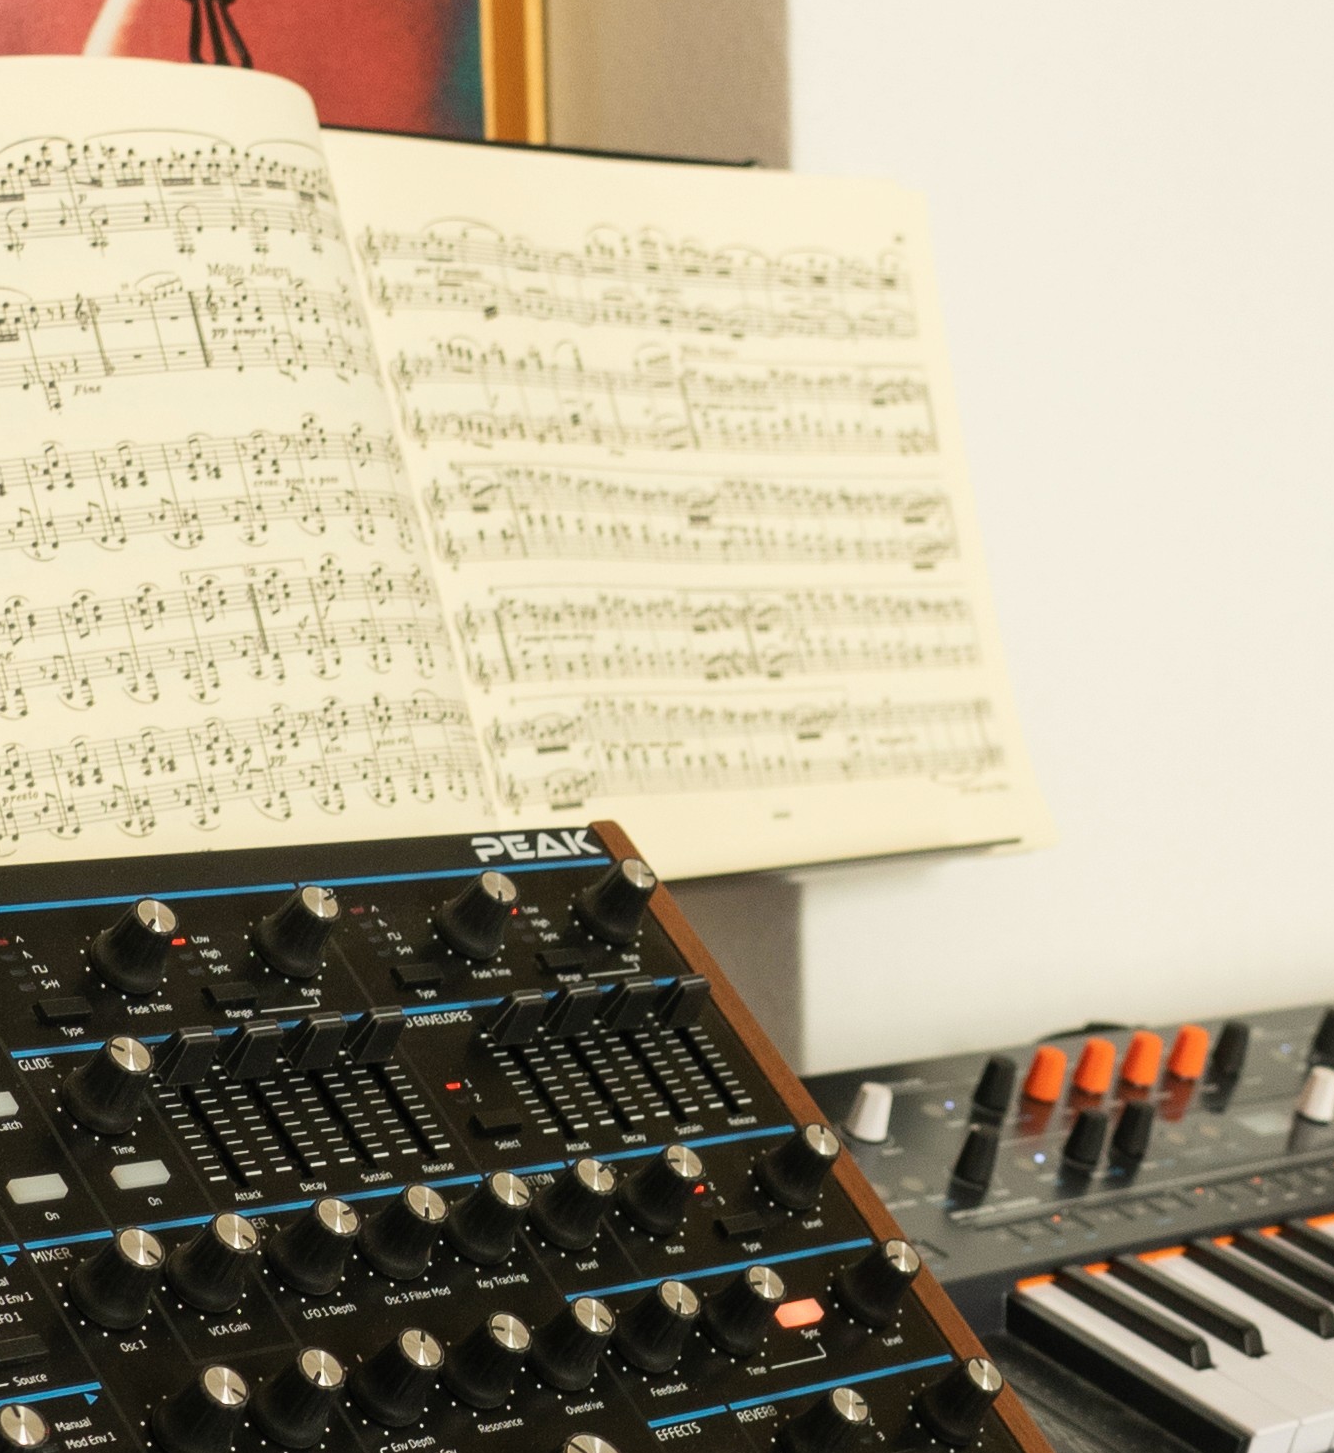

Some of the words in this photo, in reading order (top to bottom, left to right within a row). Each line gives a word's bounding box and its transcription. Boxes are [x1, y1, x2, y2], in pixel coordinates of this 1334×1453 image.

[472, 831, 602, 863] PEAK
[412, 1009, 473, 1027] ENVELOPES
[60, 1026, 85, 1038] Type
[17, 1056, 54, 1072] GLIDE
[111, 1145, 137, 1155] Time
[360, 1171, 394, 1184] Sustain
[299, 1181, 328, 1193] Decay
[147, 1196, 163, 1207] On
[234, 1189, 264, 1202] Attack
[44, 1211, 61, 1222] On
[30, 1247, 70, 1264] MIXER
[476, 1279, 495, 1290] Key
[491, 1273, 530, 1286] Tracking
[4, 1293, 25, 1305] Env
[24, 1291, 34, 1302] 1
[384, 1295, 403, 1306] Osc
[400, 1292, 410, 1303] 3
[408, 1290, 432, 1301] Filter
[430, 1285, 452, 1297] Mod
[13, 1311, 23, 1322] 1
[302, 1307, 323, 1320] LFO
[321, 1306, 330, 1317] 1
[328, 1303, 357, 1316] Depth
[207, 1324, 230, 1337] VCA
[228, 1322, 251, 1334] Gain
[119, 1342, 140, 1353] Osc
[138, 1339, 148, 1350] 1
[12, 1373, 48, 1387] Source
[736, 1404, 778, 1424] REVERB
[476, 1417, 524, 1434] Resonance
[655, 1422, 701, 1441] EFFECTS
[390, 1442, 409, 1453] Env
[407, 1435, 436, 1450] Depth
